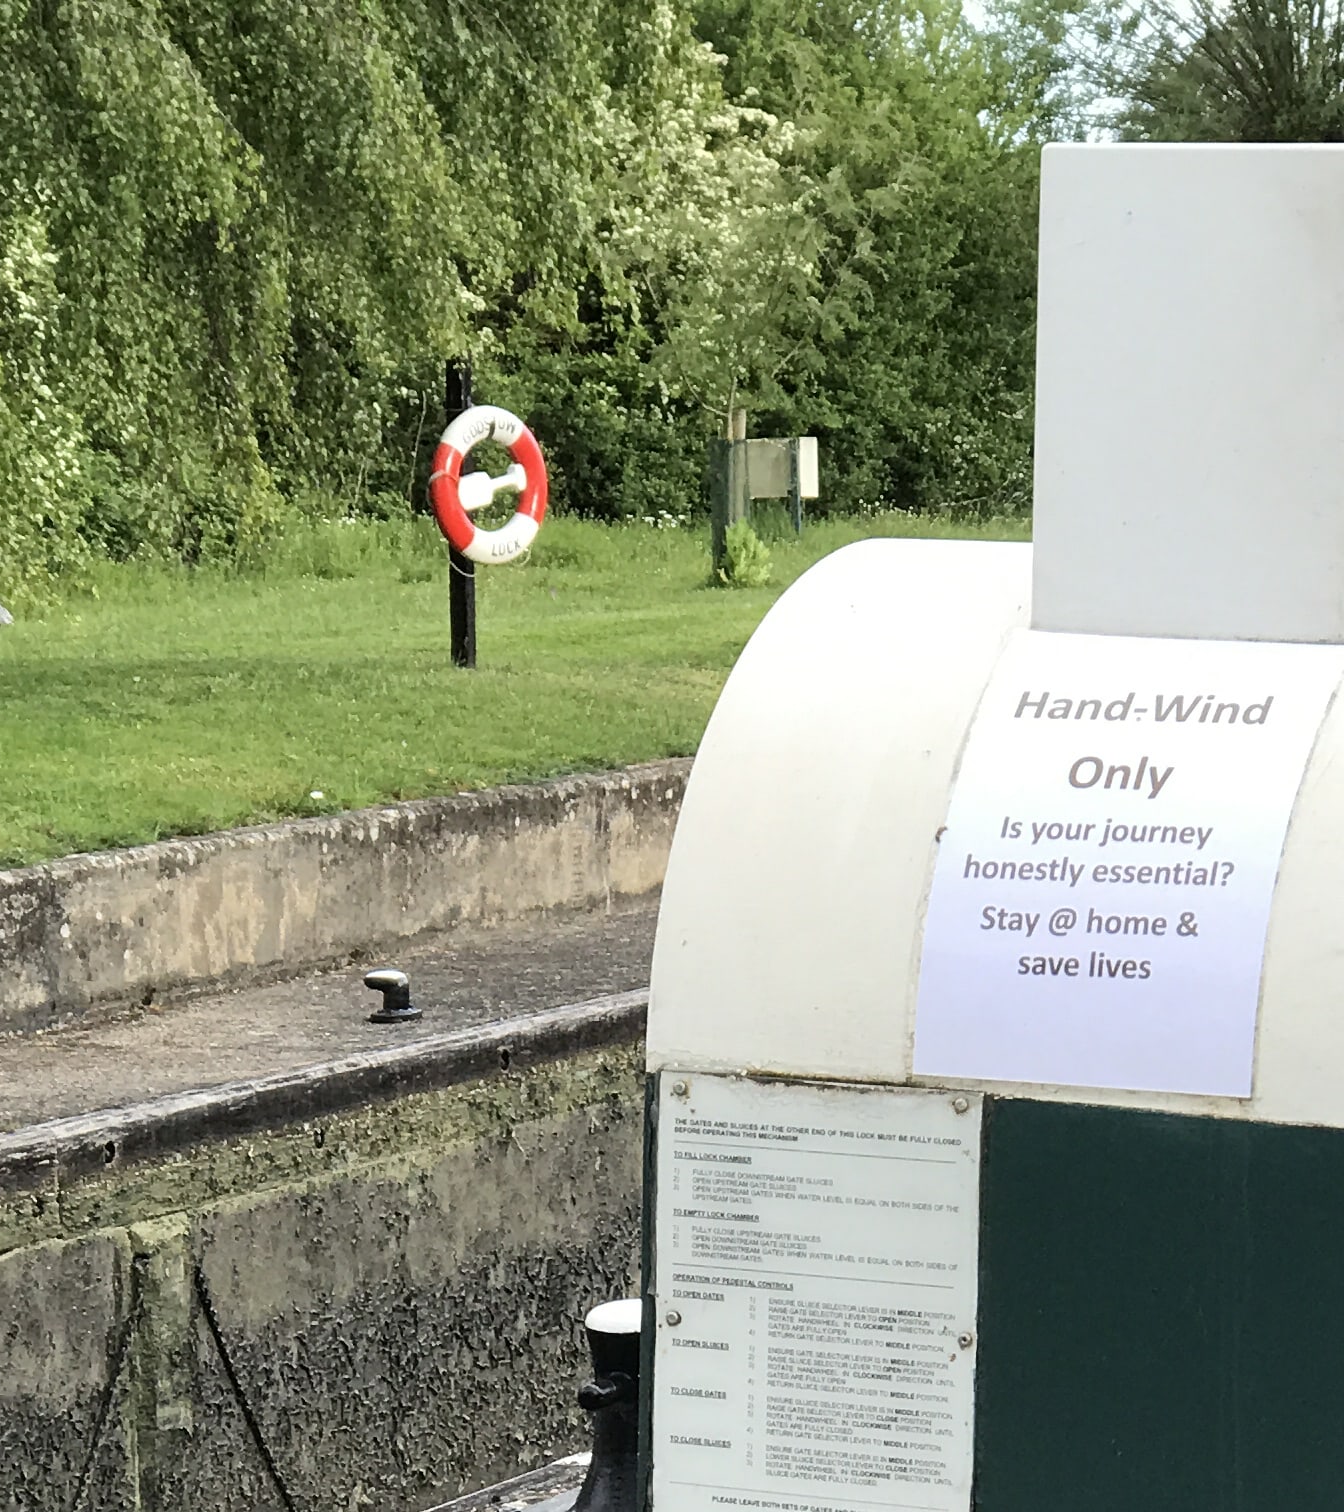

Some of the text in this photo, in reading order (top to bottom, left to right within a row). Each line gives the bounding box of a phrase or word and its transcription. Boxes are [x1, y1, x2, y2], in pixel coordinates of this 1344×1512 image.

[491, 538, 521, 557] LOCK
[1014, 691, 1274, 725] Hand-Wind
[1068, 756, 1175, 800] Only
[1000, 816, 1214, 850] Is your journey
[963, 854, 1235, 888] honestly essential?
[980, 905, 1199, 938] Stay @ home &
[1017, 951, 1152, 980] save lives
[673, 1125, 700, 1135] BEFORE
[701, 1127, 741, 1138] OPERATING
[742, 1130, 757, 1139] THIS
[674, 1117, 687, 1126] THE
[689, 1118, 712, 1128] GATES
[713, 1120, 728, 1129] AND
[759, 1123, 769, 1132] AT
[770, 1124, 784, 1133] THE
[785, 1125, 809, 1135] OTHER
[810, 1127, 825, 1136] END
[827, 1128, 836, 1137] OF
[839, 1129, 854, 1138] THIS
[855, 1130, 875, 1140] LOCK
[876, 1132, 896, 1141] MUST
[898, 1133, 908, 1142] BE
[909, 1134, 931, 1144] FULLY
[933, 1136, 961, 1146] CLOSED
[673, 1150, 752, 1163] TO FILL LOCK CHAMBER
[682, 1209, 705, 1217] EMPTY
[706, 1210, 725, 1219] LOCK
[726, 1212, 759, 1222] CHAMBER
[672, 1272, 710, 1283] OPERATION
[711, 1275, 720, 1284] OF
[757, 1279, 793, 1290] CONTROLS
[672, 1289, 724, 1300] TO OPEN GATES
[671, 1337, 681, 1346] TO
[681, 1338, 701, 1347] OPEN
[670, 1385, 726, 1399] TO CLOSE GATES
[669, 1434, 679, 1443] TO
[679, 1435, 702, 1445] CLOSE
[711, 1495, 737, 1505] PLEASE
[738, 1497, 760, 1507] LEAVE
[761, 1500, 780, 1509] BOTH
[781, 1502, 798, 1511] SETS
[799, 1504, 808, 1512] OF
